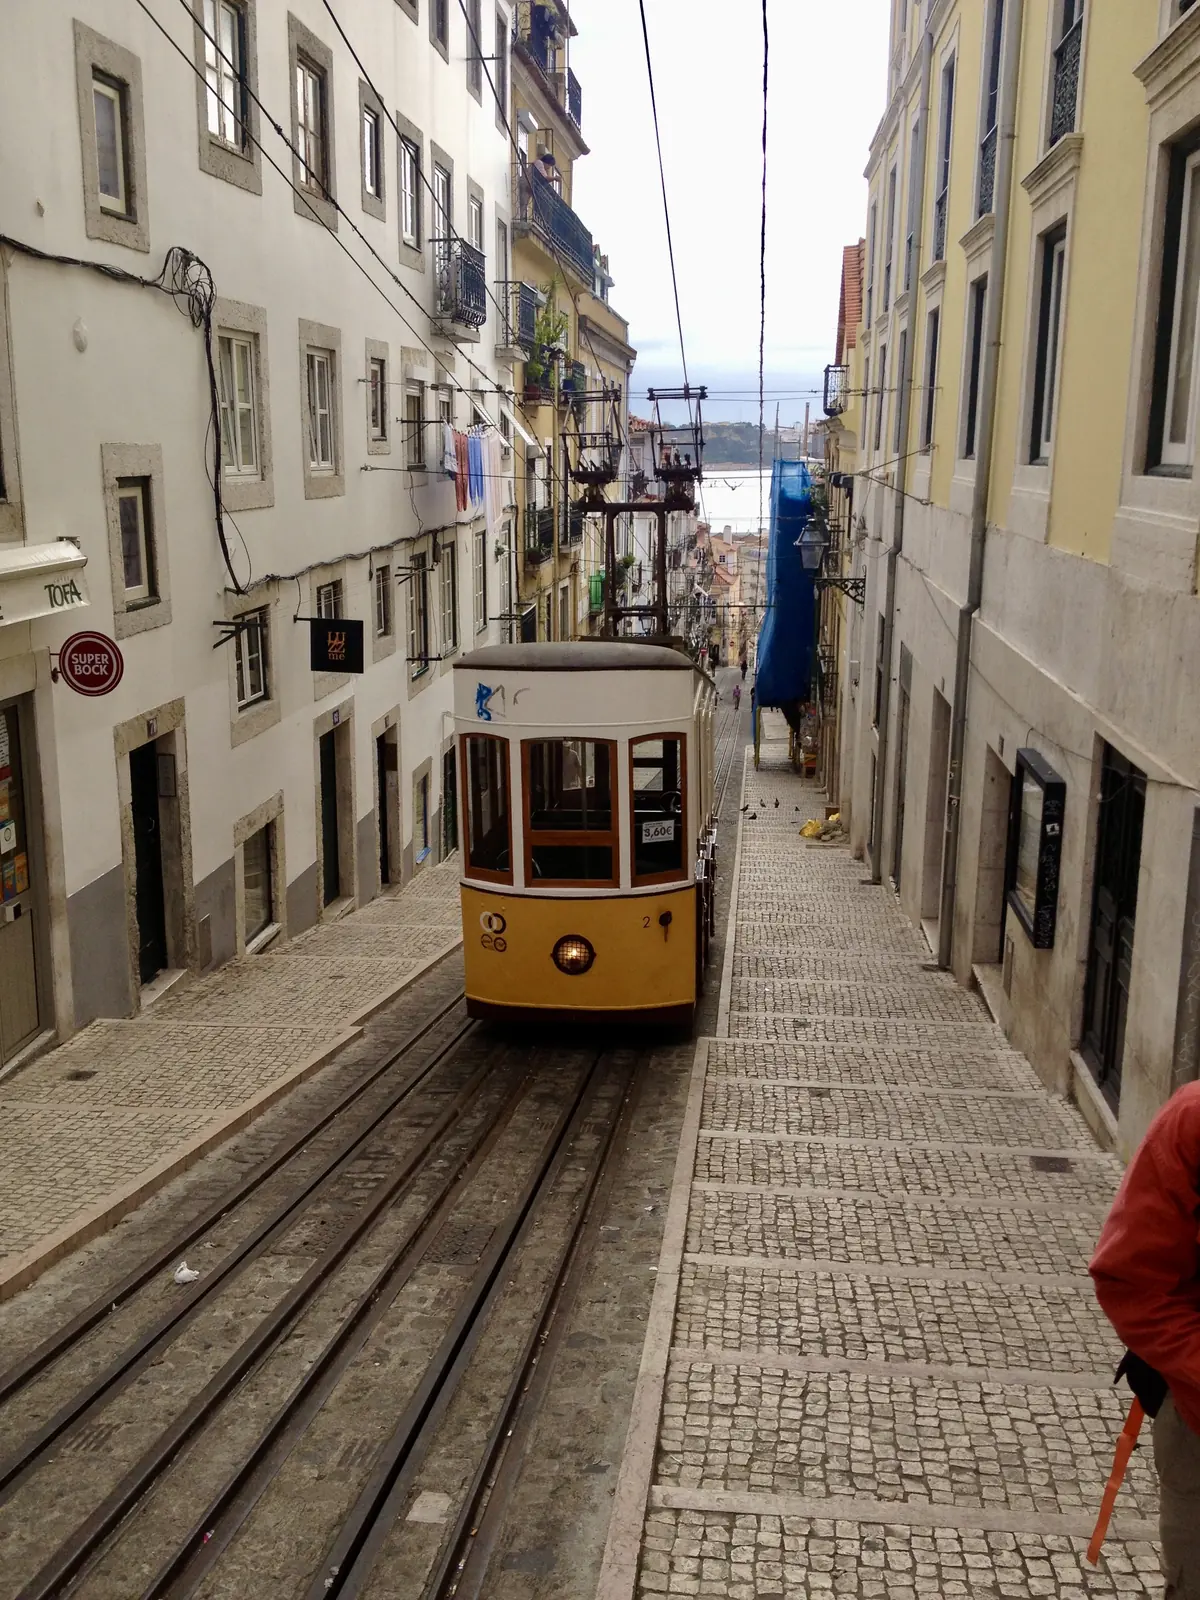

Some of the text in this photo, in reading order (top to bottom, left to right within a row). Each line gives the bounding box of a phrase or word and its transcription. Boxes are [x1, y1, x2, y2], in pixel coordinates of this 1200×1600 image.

[44, 579, 82, 608] TOFA
[71, 653, 109, 665] SUPER
[74, 664, 109, 676] BOCK
[643, 826, 672, 839] 3,60€
[642, 915, 651, 929] 2
